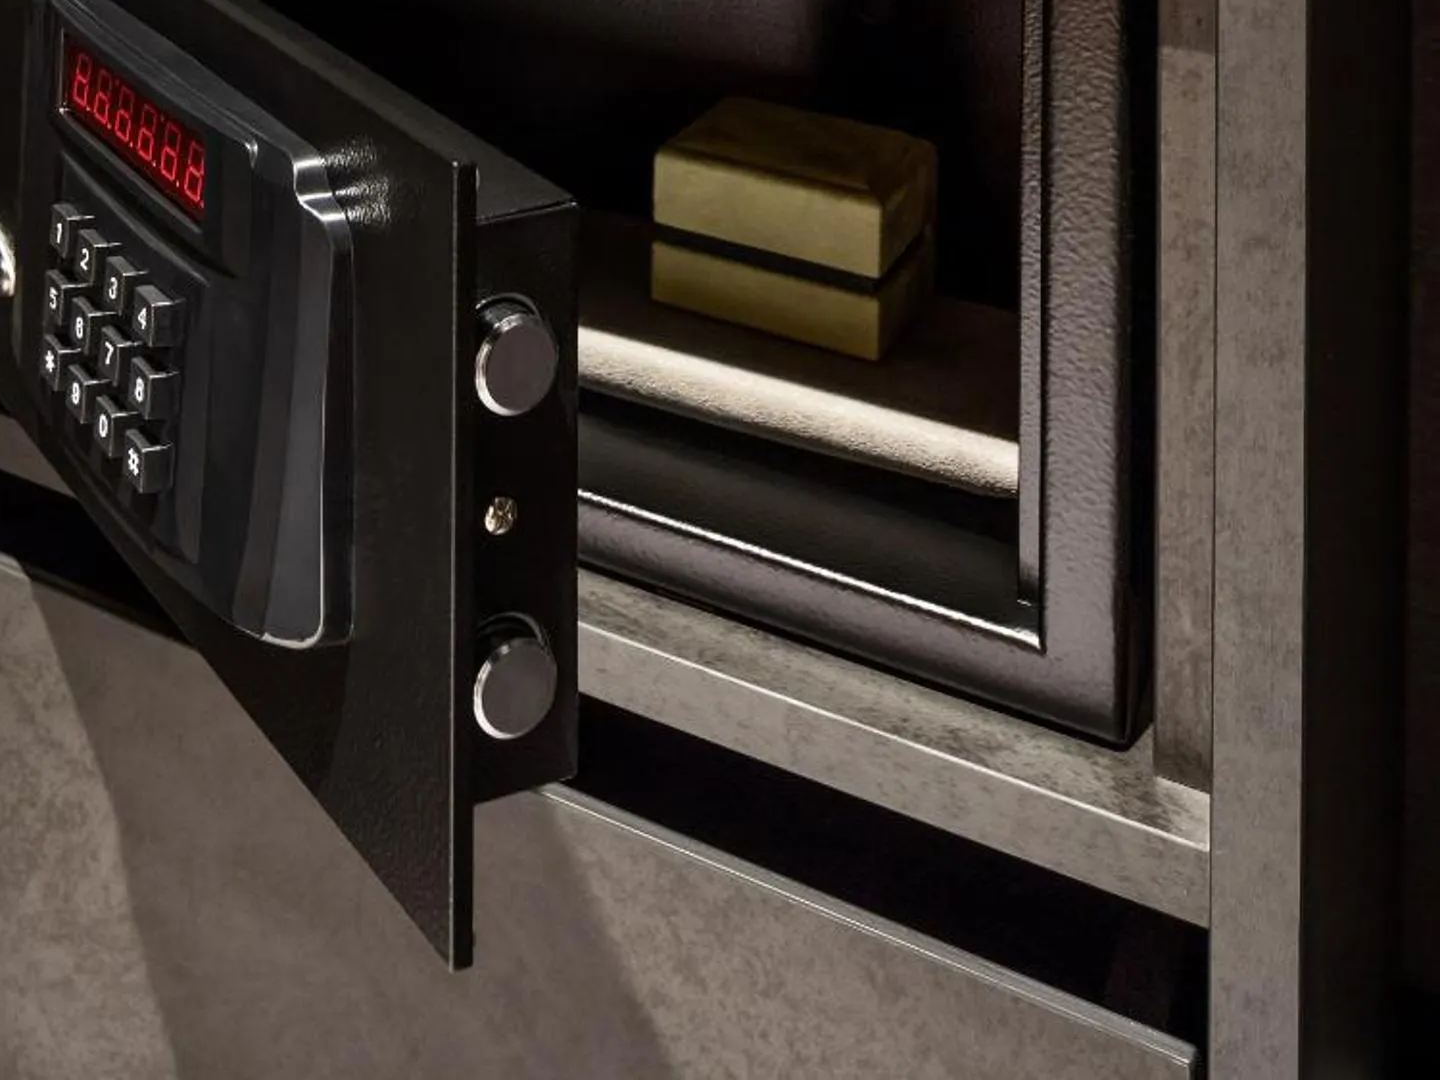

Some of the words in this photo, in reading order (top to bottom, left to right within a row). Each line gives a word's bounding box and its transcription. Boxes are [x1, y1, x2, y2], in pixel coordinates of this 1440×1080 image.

[56, 222, 63, 244] 1
[79, 247, 90, 271] 2
[108, 276, 118, 300] 3
[137, 307, 147, 330] 4
[49, 286, 58, 310] 5
[104, 341, 115, 365] 7
[134, 376, 145, 403] 8
[98, 413, 109, 438] 0
